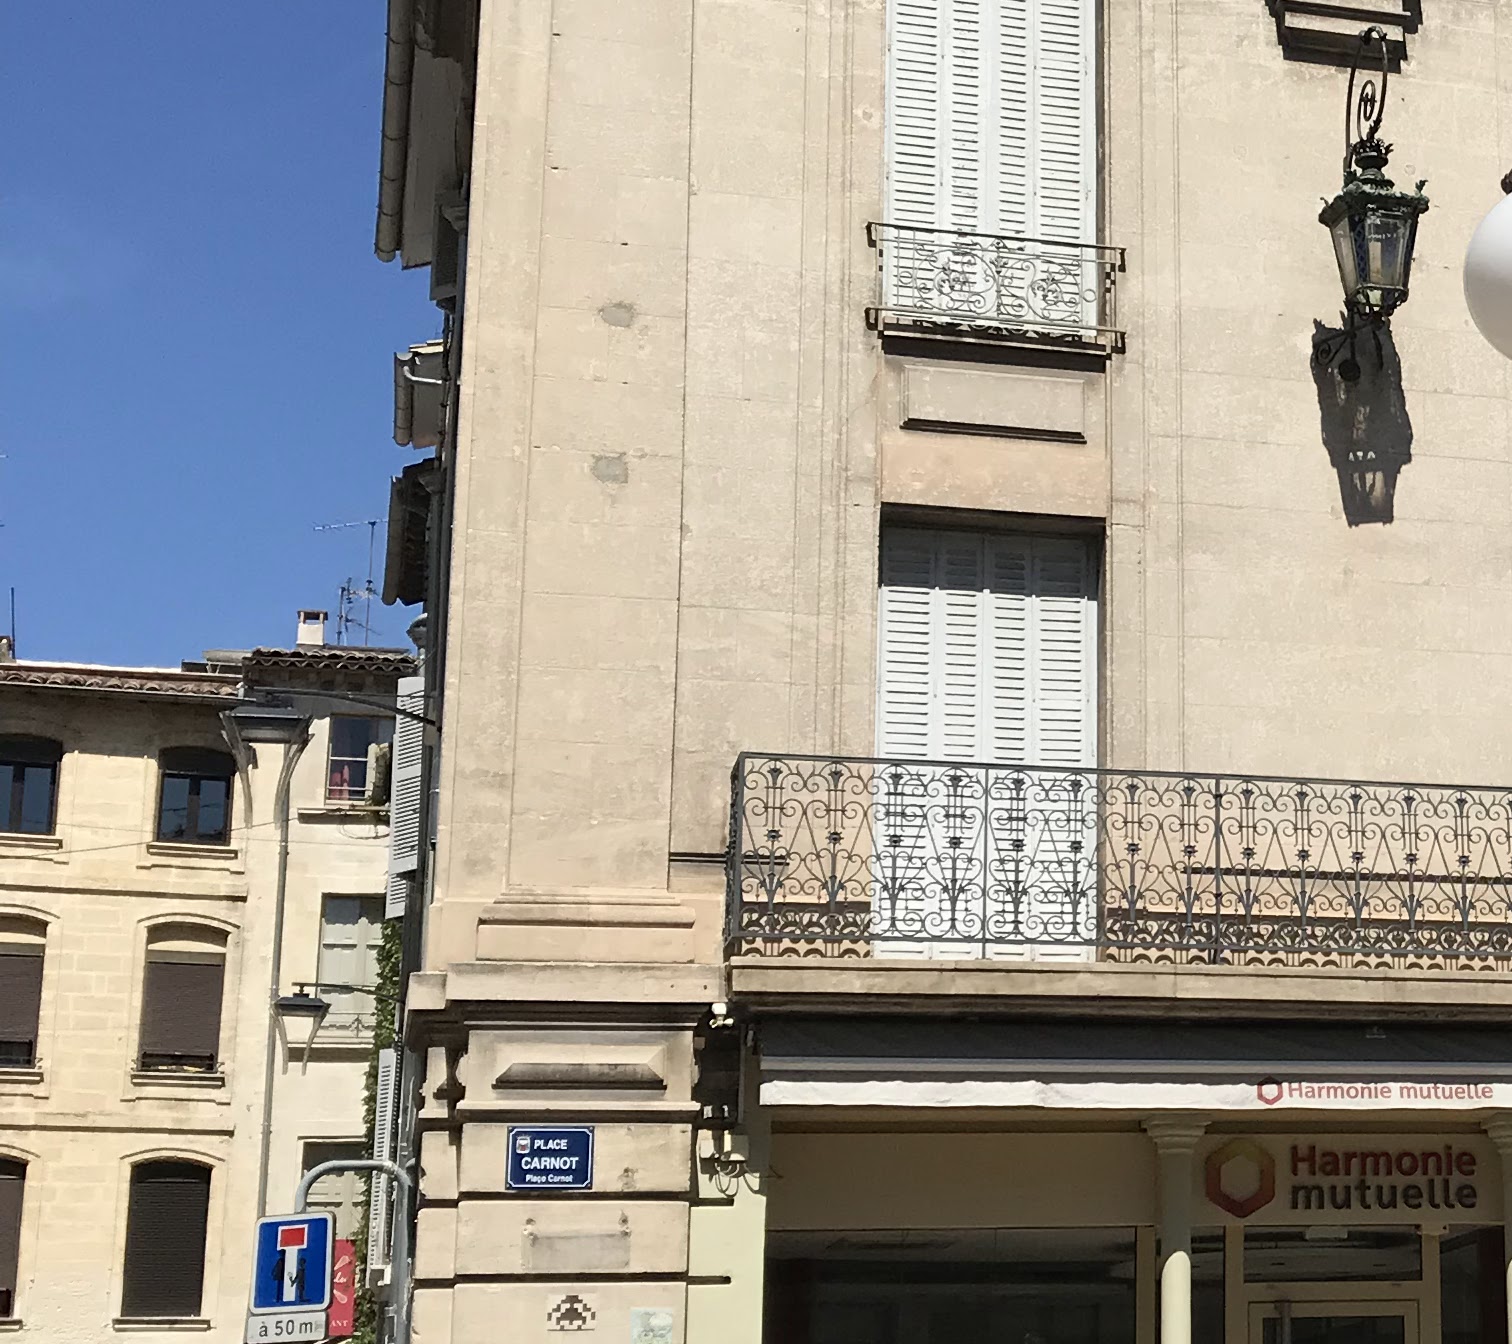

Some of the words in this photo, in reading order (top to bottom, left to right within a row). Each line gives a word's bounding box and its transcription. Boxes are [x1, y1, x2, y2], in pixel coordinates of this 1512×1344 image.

[1288, 1081, 1392, 1100] Harmonie
[1399, 1082, 1494, 1100] mutuelle
[534, 1139, 568, 1150] PLACE
[521, 1157, 579, 1170] CARNOT
[1290, 1144, 1477, 1177] Harmonie
[548, 1174, 573, 1182] Carnot
[1290, 1178, 1478, 1210] mutuelle
[258, 1321, 268, 1337] à
[274, 1319, 295, 1336] 50
[299, 1321, 313, 1334] m
